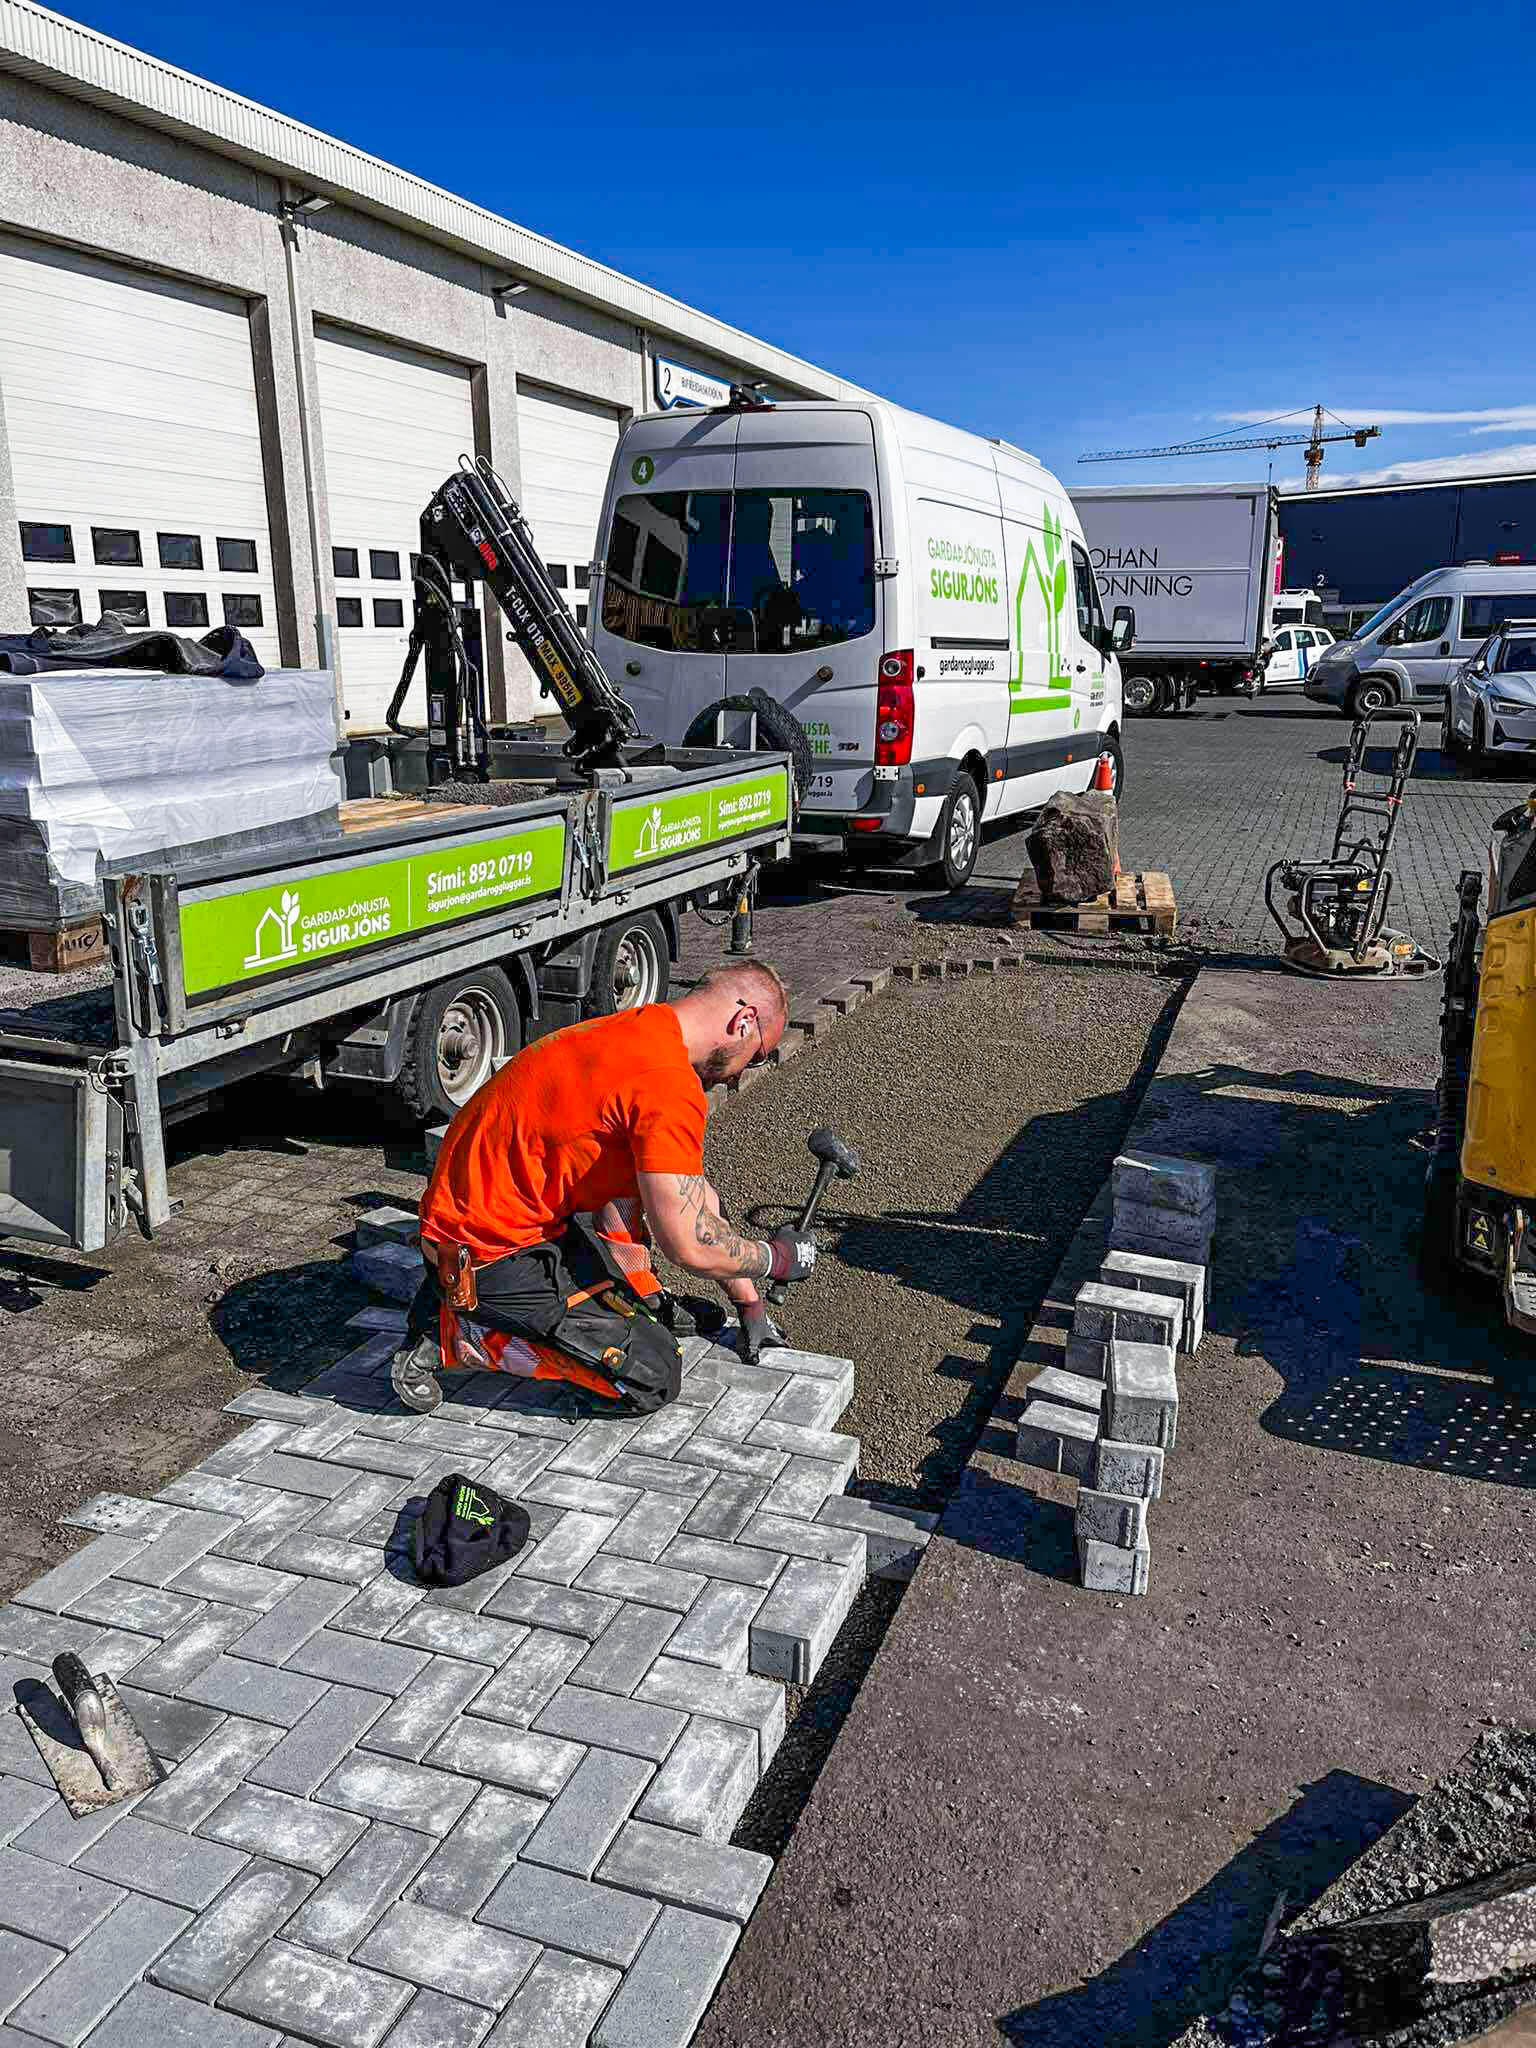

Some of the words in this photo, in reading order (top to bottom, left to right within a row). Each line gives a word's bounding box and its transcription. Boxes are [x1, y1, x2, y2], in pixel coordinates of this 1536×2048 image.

[663, 367, 672, 396] 2
[638, 461, 648, 480] 4
[1088, 547, 1158, 569] OHAN
[930, 567, 998, 605] SIGURJÓNS
[1095, 571, 1193, 597] ÖNNING
[504, 585, 531, 624] T-CLX
[809, 775, 833, 787] 719
[427, 866, 466, 896] Sími:
[469, 859, 496, 884] 892
[499, 850, 533, 877] 0719
[301, 896, 390, 929] GARÐAÞJÓNUSTA
[302, 913, 391, 953] SIGURJÓNS
